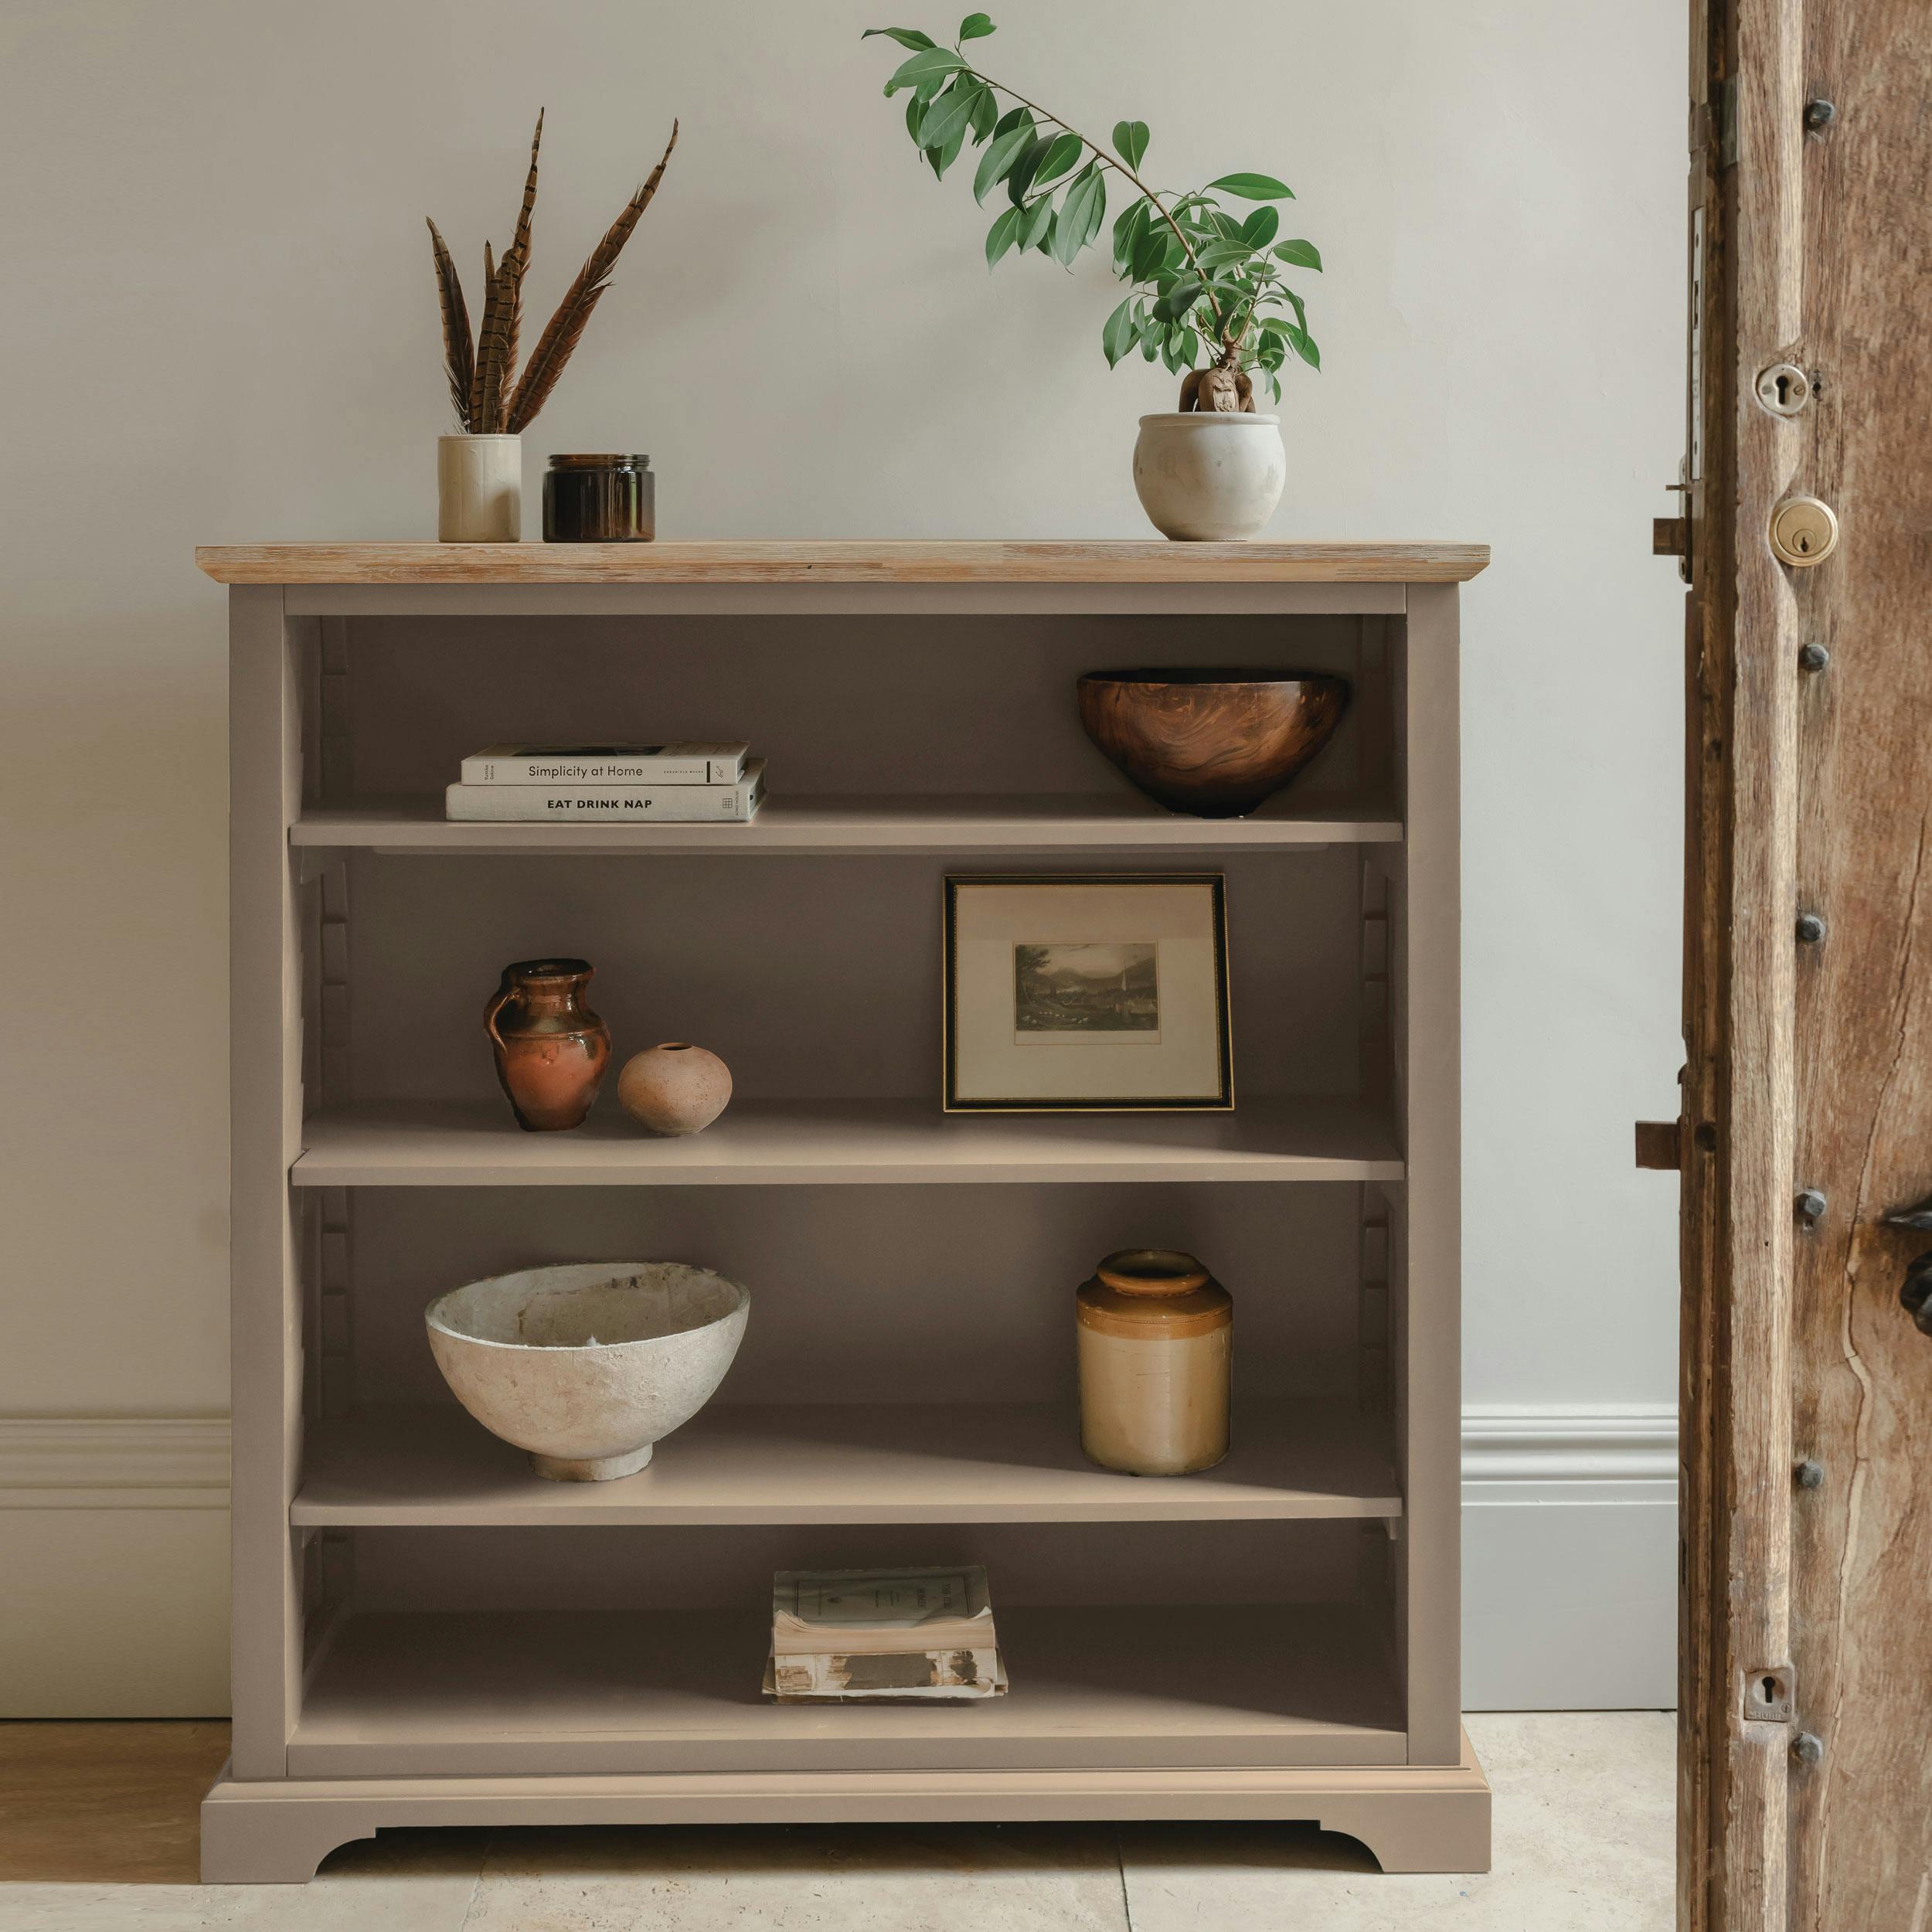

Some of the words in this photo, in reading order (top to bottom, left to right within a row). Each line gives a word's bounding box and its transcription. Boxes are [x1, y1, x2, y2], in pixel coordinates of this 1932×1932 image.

[529, 766, 587, 779] Simplicity
[591, 767, 604, 776] at
[608, 766, 643, 776] Home
[547, 800, 572, 809] EAT
[577, 800, 619, 809] DRINK
[624, 800, 652, 809] NAP
